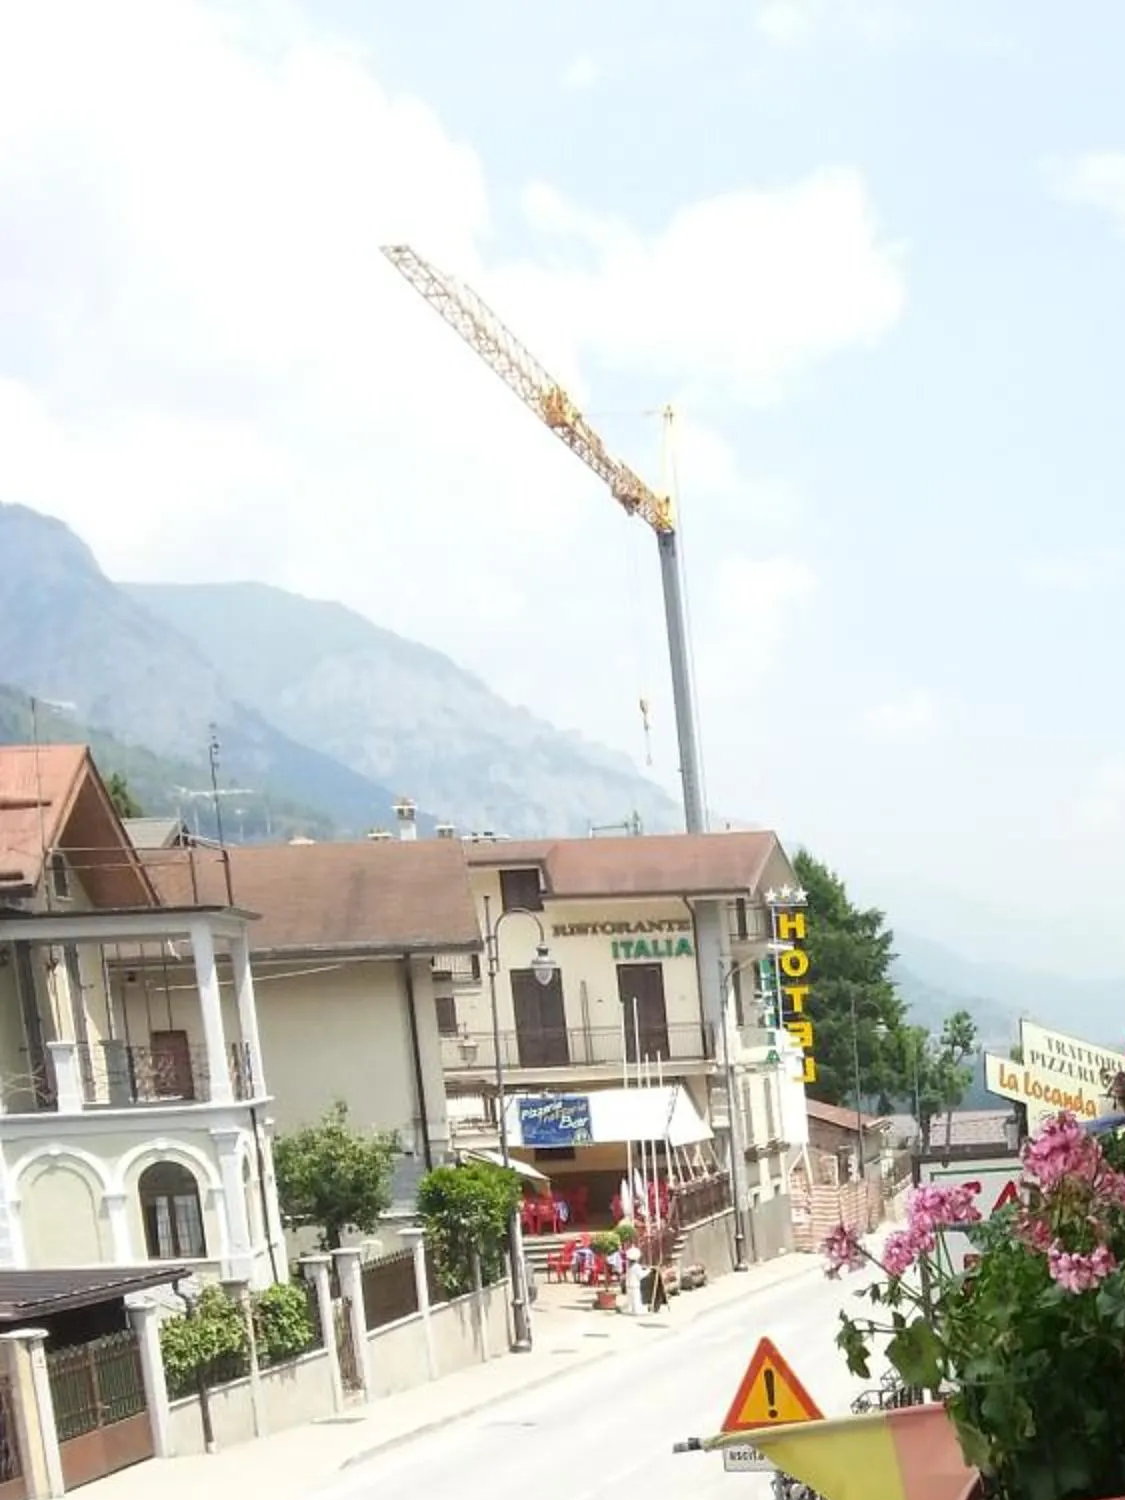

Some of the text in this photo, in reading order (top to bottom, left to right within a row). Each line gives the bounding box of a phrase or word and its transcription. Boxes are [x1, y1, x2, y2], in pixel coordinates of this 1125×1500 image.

[552, 919, 691, 937] RISTORANTE
[611, 937, 693, 959] ITALIA
[1045, 1034, 1125, 1072] TRATTORI
[1030, 1050, 1099, 1085] PIZZERI
[1023, 1070, 1097, 1118] Locanda
[559, 1115, 589, 1129] Bar
